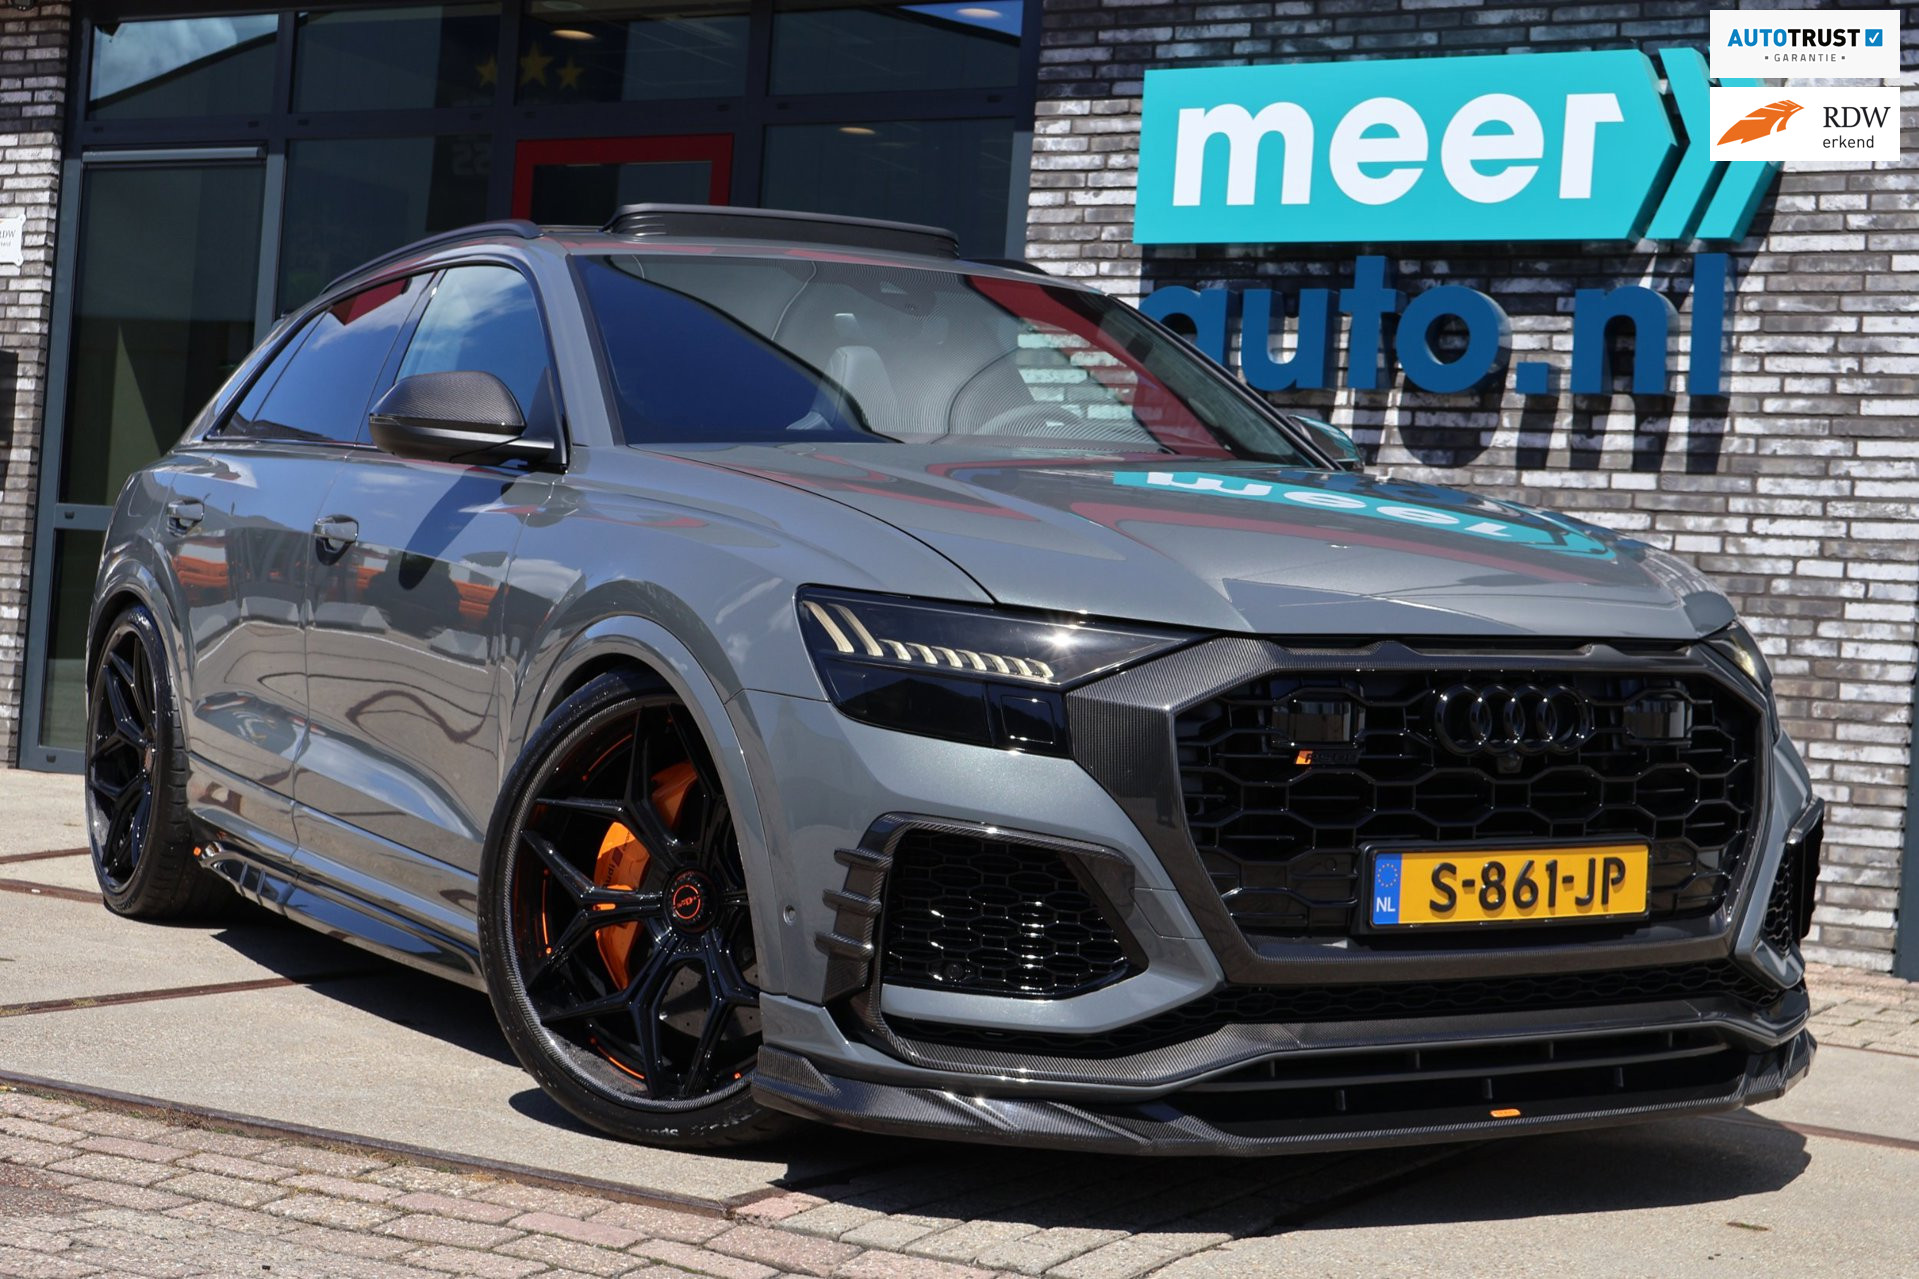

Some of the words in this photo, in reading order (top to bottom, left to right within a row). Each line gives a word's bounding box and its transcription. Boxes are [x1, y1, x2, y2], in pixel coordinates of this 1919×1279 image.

[1172, 93, 1625, 207] meer
[1138, 252, 1732, 395] auto.nl
[1376, 897, 1397, 912] NL
[1429, 856, 1626, 913] S-861-JP
